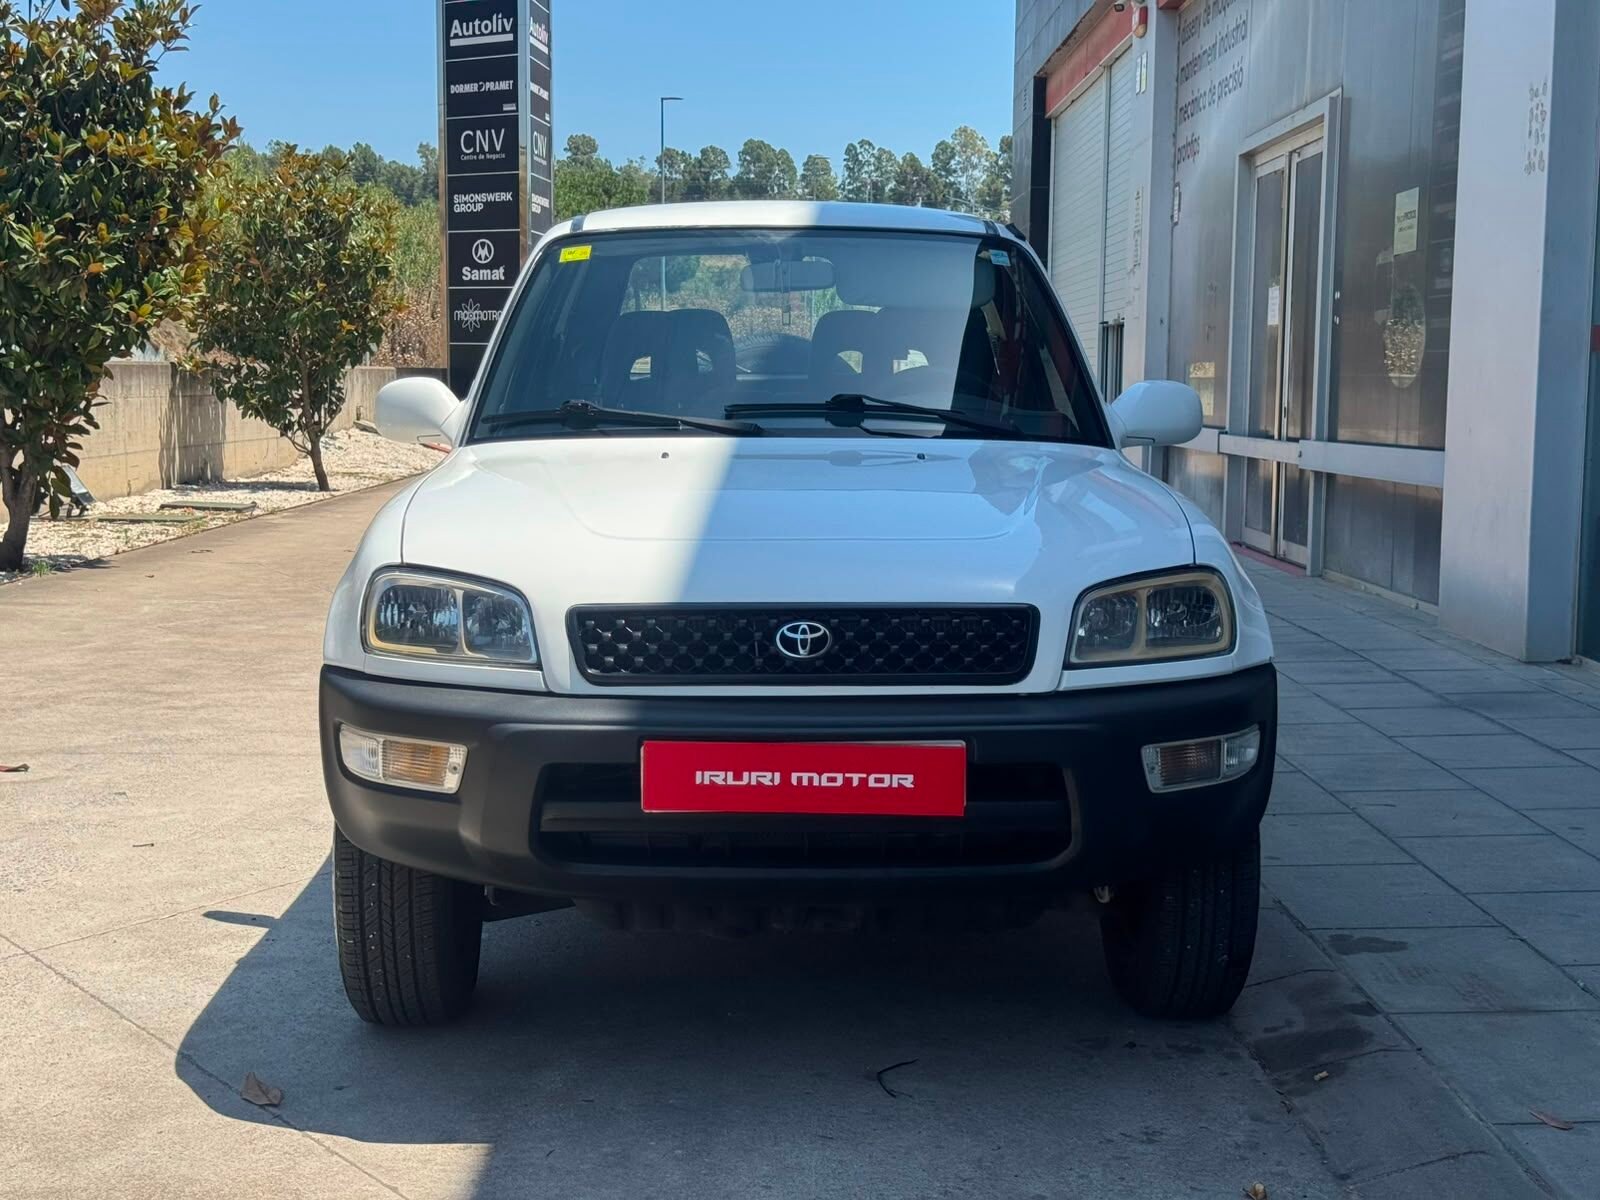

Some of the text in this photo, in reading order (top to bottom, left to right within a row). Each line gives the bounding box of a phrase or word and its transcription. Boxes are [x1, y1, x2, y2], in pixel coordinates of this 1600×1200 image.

[450, 12, 514, 38] Autoliv
[450, 80, 514, 94] DORMER PRAMET
[460, 128, 505, 153] CNV
[533, 131, 547, 159] CNV
[453, 192, 513, 203] SIMONSWERK
[453, 203, 484, 213] GROUP
[462, 266, 505, 281] Samat
[695, 770, 915, 788] IRURI MOTOR
